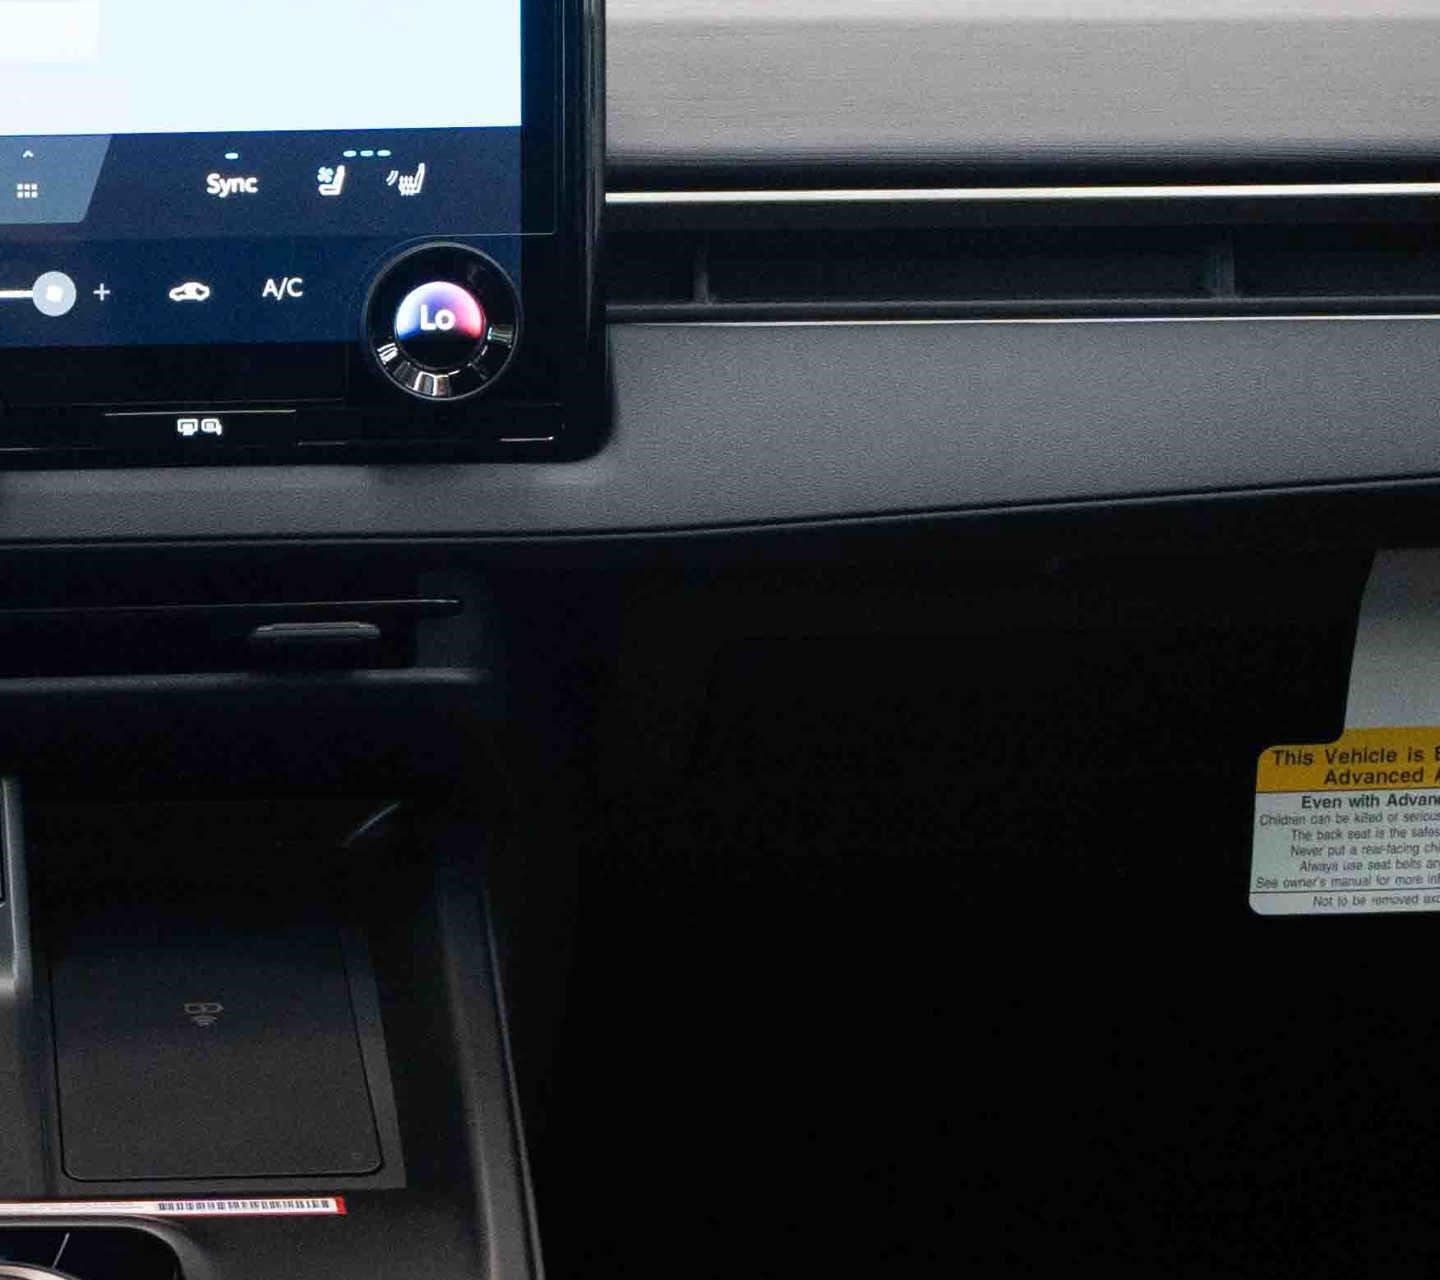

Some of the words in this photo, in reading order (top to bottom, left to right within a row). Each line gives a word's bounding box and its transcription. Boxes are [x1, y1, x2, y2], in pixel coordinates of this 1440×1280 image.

[206, 172, 258, 198] Sync
[263, 277, 304, 299] A/C
[419, 304, 456, 330] Lo
[1271, 749, 1314, 766] This
[1324, 747, 1397, 764] Vehicle
[1408, 747, 1425, 763] is
[1323, 768, 1424, 784] Advanced
[1301, 795, 1342, 809] Even
[1348, 793, 1380, 808] with
